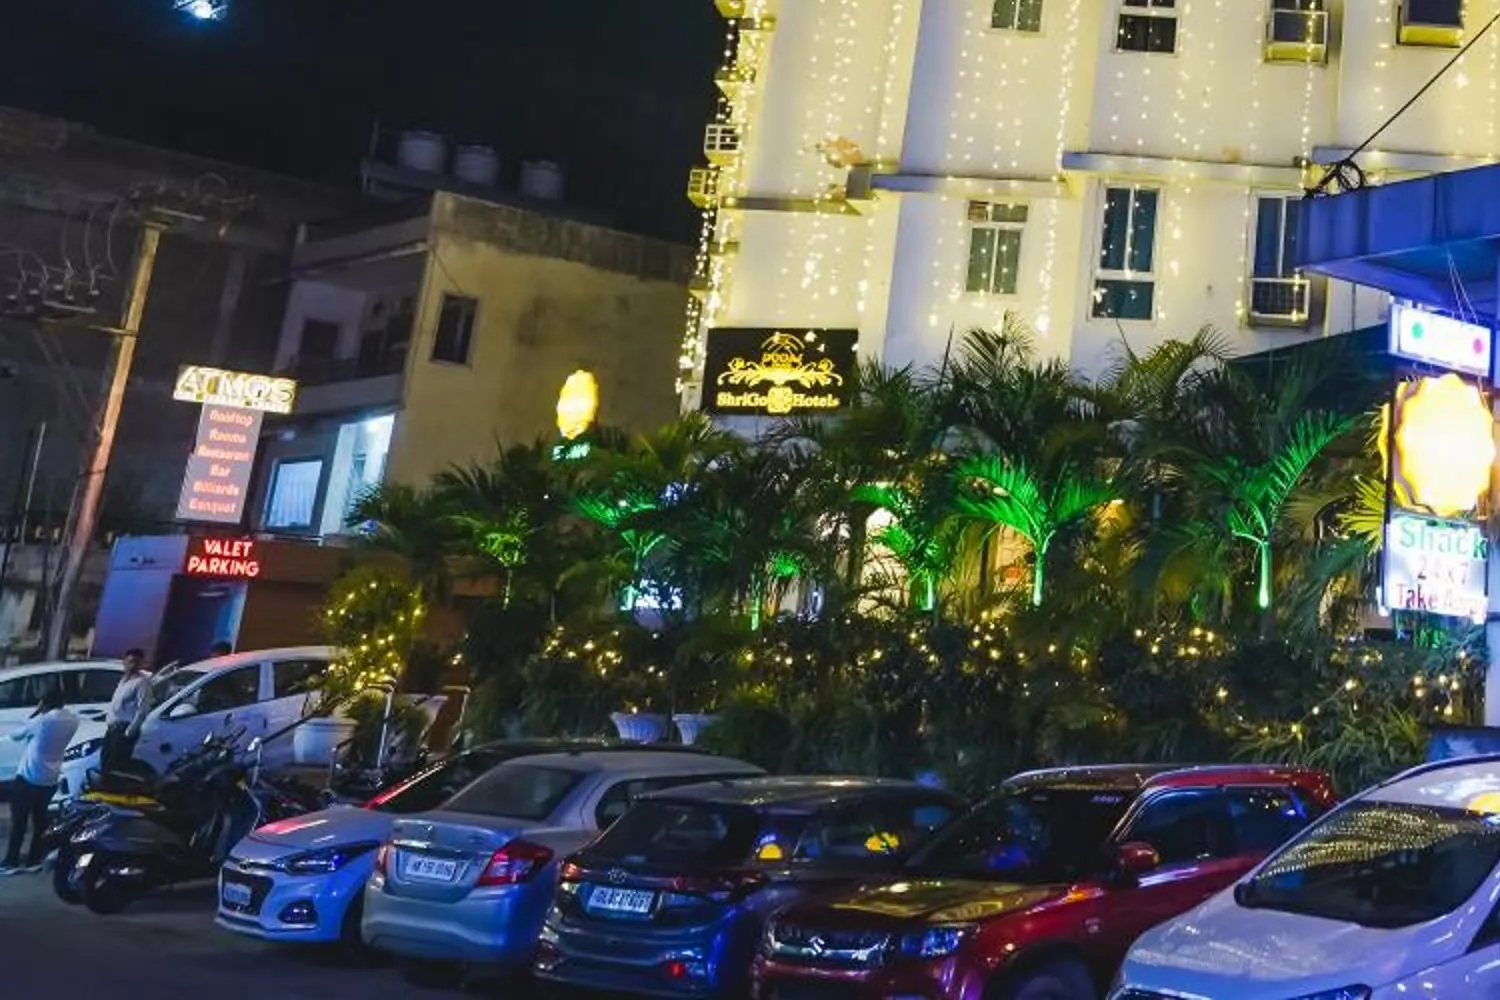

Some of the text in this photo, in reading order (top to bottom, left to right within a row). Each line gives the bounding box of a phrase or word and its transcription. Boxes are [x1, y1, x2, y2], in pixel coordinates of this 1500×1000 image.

[177, 366, 295, 404] ATMOS
[793, 393, 841, 408] Hotels
[204, 538, 253, 557] VALET
[187, 556, 260, 577] PARKING
